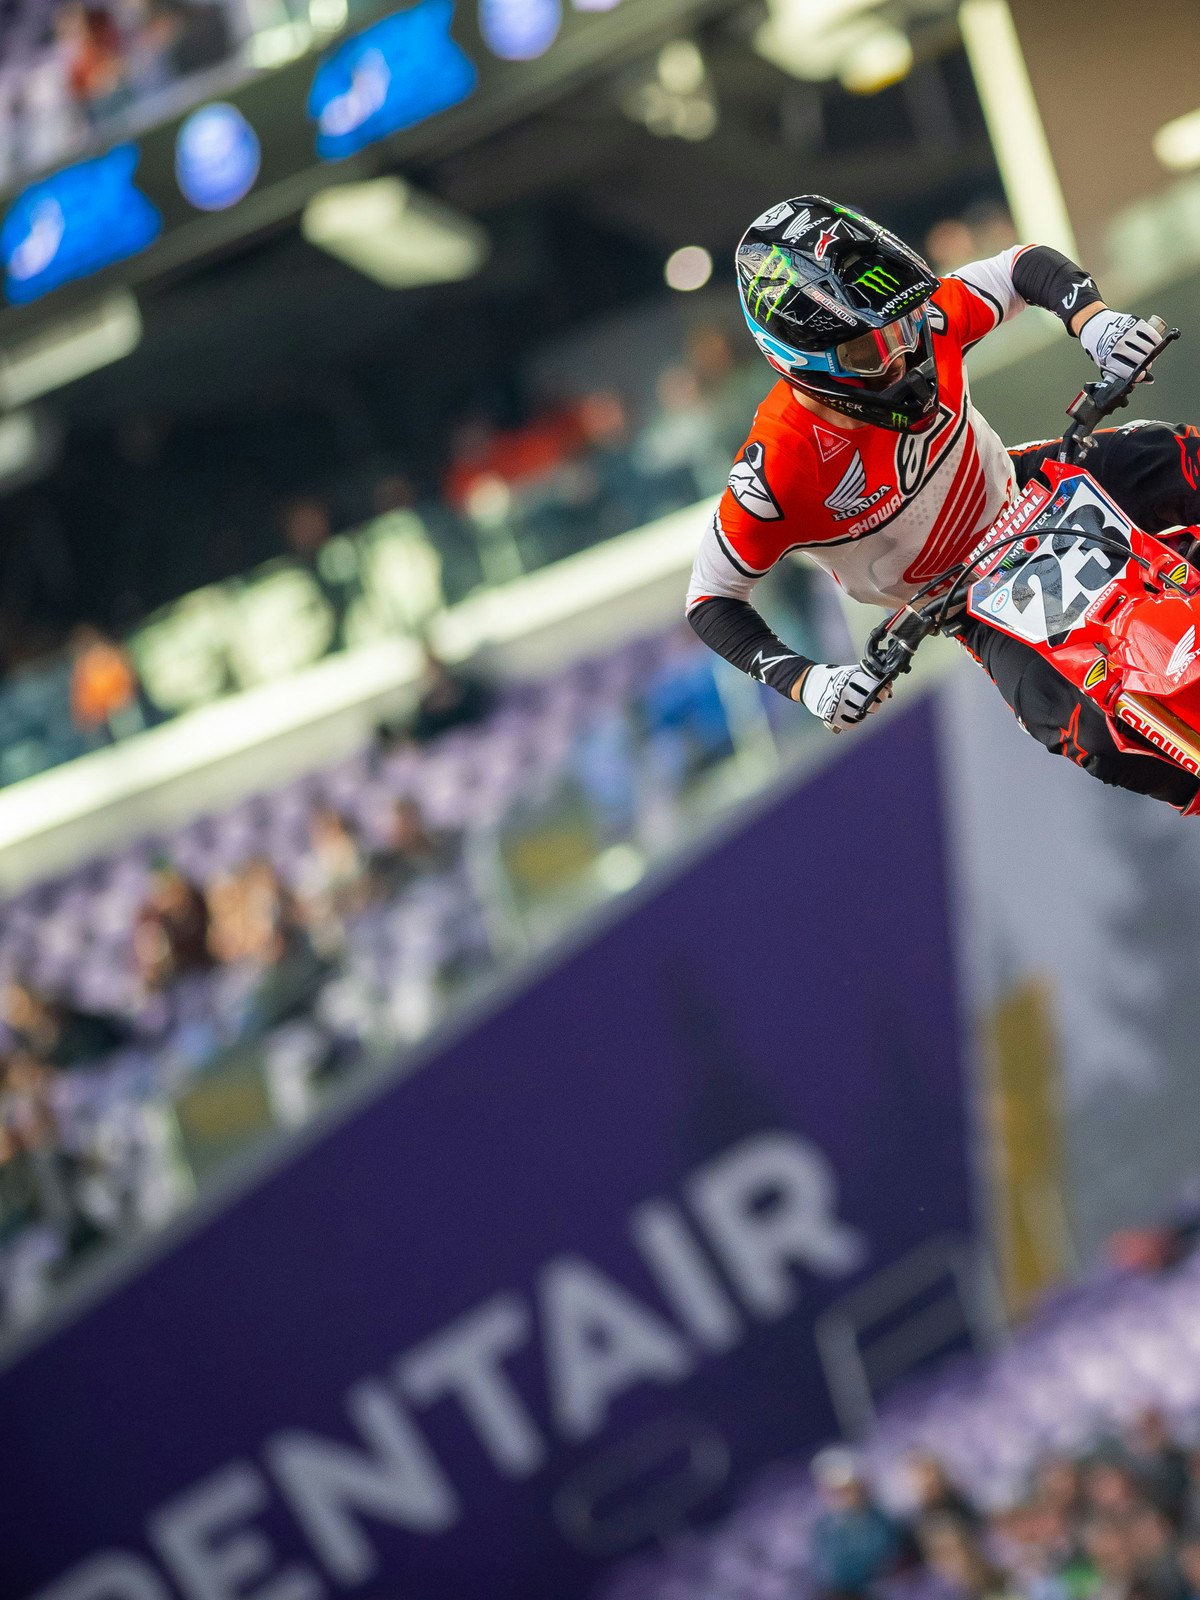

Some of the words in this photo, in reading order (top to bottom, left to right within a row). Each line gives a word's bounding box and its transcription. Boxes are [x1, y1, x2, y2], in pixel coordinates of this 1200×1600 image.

[790, 216, 831, 245] HONDA
[876, 281, 930, 317] MONSTER
[826, 352, 836, 374] OAKLEY
[832, 484, 892, 522] HONDA
[848, 493, 902, 538] SHOWA
[1012, 504, 1132, 648] 23
[1085, 582, 1119, 620] HONDA
[1119, 706, 1200, 776] SHOWA
